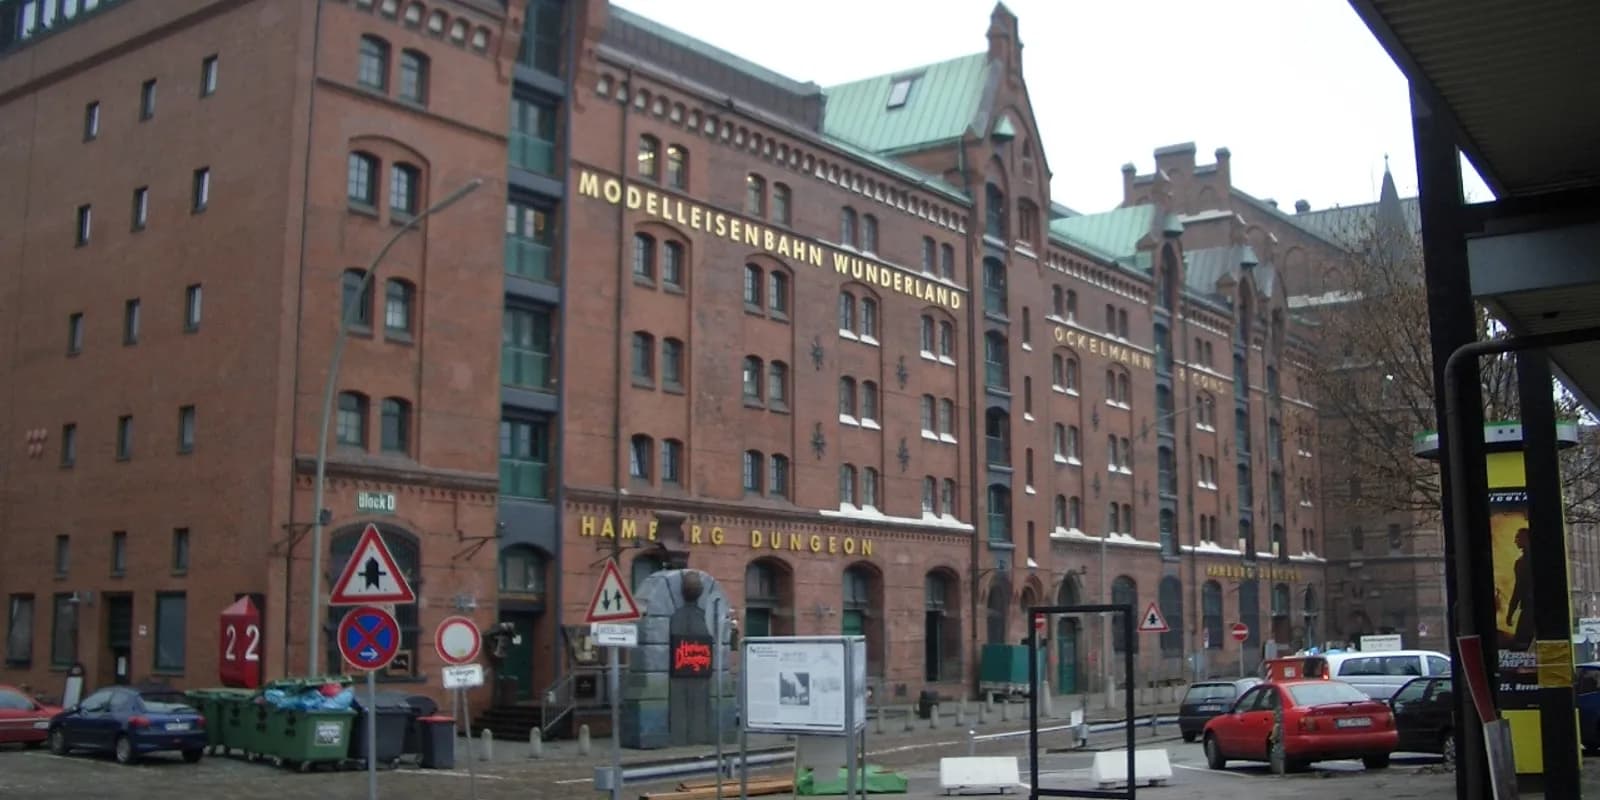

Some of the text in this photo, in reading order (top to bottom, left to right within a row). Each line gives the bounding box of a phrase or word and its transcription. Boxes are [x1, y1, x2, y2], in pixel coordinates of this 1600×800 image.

[578, 170, 963, 311] MODELLEISENBAHN WUNDERLAND
[1054, 326, 1152, 370] OCKELMANN
[358, 491, 386, 510] Block
[751, 529, 873, 557] DUNGEON
